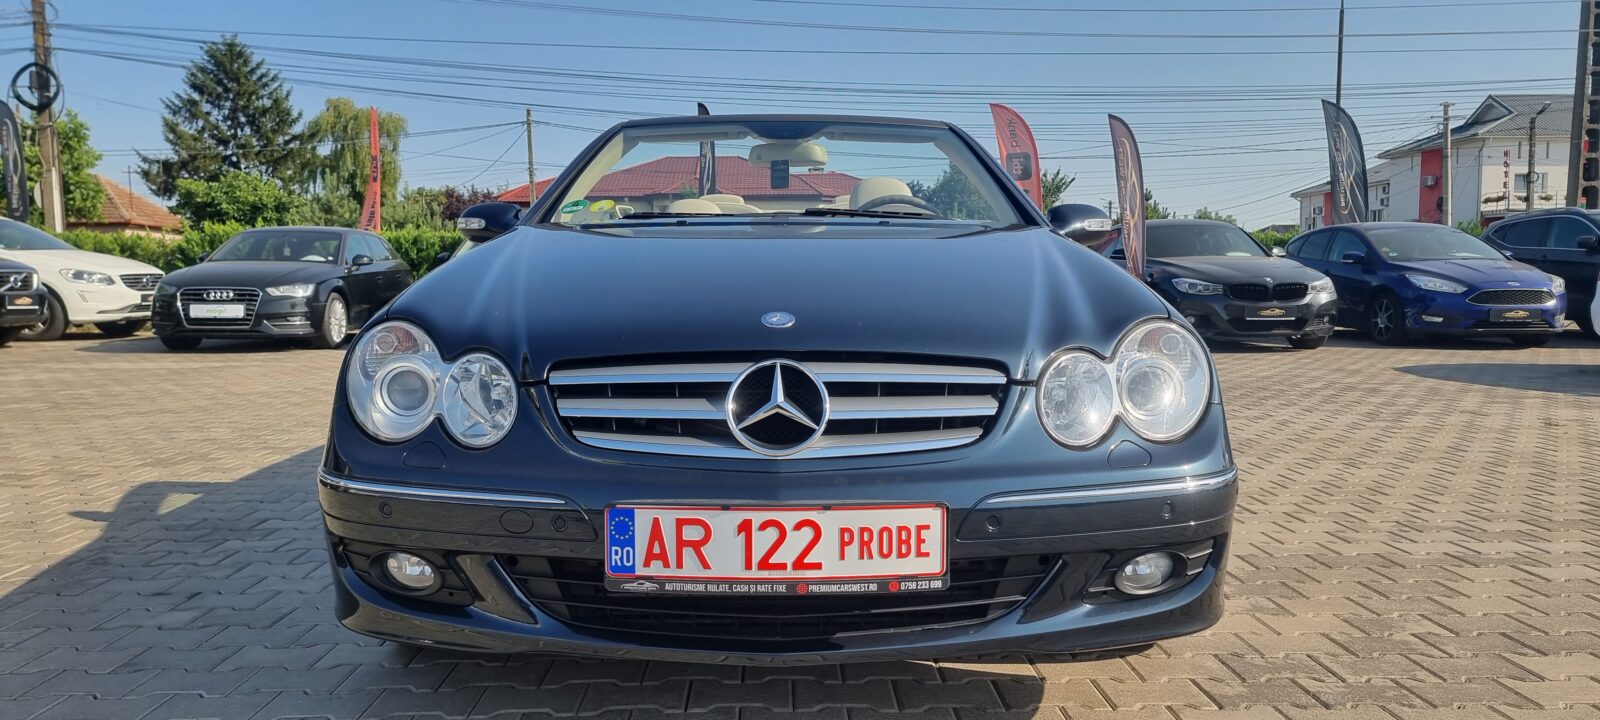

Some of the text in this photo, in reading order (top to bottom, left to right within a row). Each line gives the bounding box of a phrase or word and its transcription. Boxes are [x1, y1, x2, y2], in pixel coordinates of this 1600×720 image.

[611, 516, 931, 571] RO AR 122 PROBE
[665, 582, 706, 591] AUTOTURISME
[707, 584, 732, 592] RULATE,
[732, 584, 749, 592] CASH
[808, 583, 878, 593] PREMIUMCARSWEST.RO
[917, 580, 930, 589] 233
